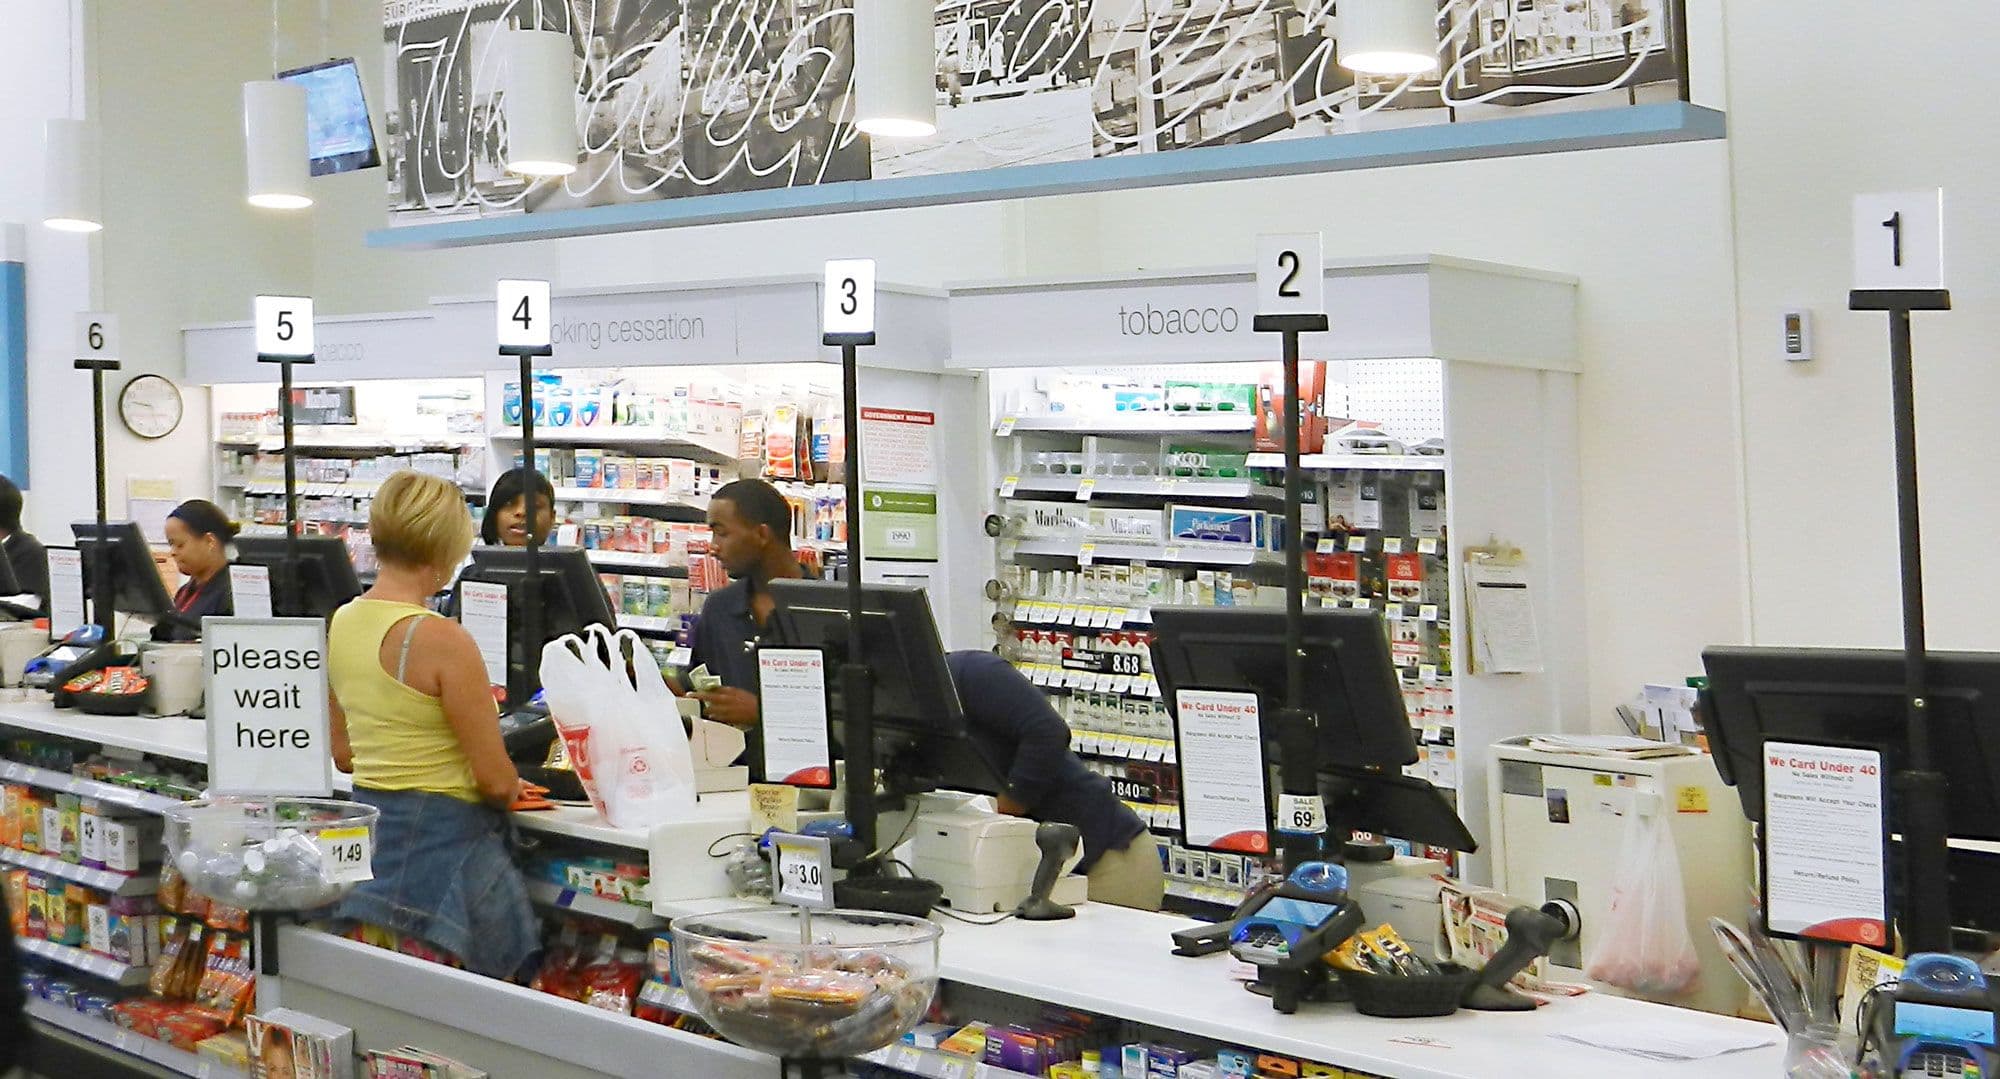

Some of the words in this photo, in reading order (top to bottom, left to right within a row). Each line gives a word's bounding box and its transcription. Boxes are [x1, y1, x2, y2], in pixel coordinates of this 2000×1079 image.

[1882, 211, 1901, 267] 1
[1277, 250, 1300, 297] 2
[840, 277, 857, 315] 3
[277, 311, 294, 341] 5
[512, 295, 532, 330] 4
[1118, 303, 1239, 336] tobacco
[88, 322, 104, 351] 6
[551, 317, 601, 350] oking
[607, 312, 705, 343] cessation
[1173, 452, 1211, 468] KOOL
[213, 642, 321, 675] please
[1113, 654, 1139, 674] 8.68
[234, 684, 301, 709] wait
[1181, 702, 1193, 710] We
[1195, 702, 1214, 711] Card
[1216, 704, 1240, 713] Under
[1244, 705, 1257, 714] 40
[236, 722, 311, 749] here
[1769, 756, 1785, 767] We
[1789, 758, 1815, 769] Card
[1820, 761, 1854, 773] Under
[1859, 765, 1877, 775] 40
[1352, 831, 1372, 841] 100
[331, 843, 363, 863] $1.49
